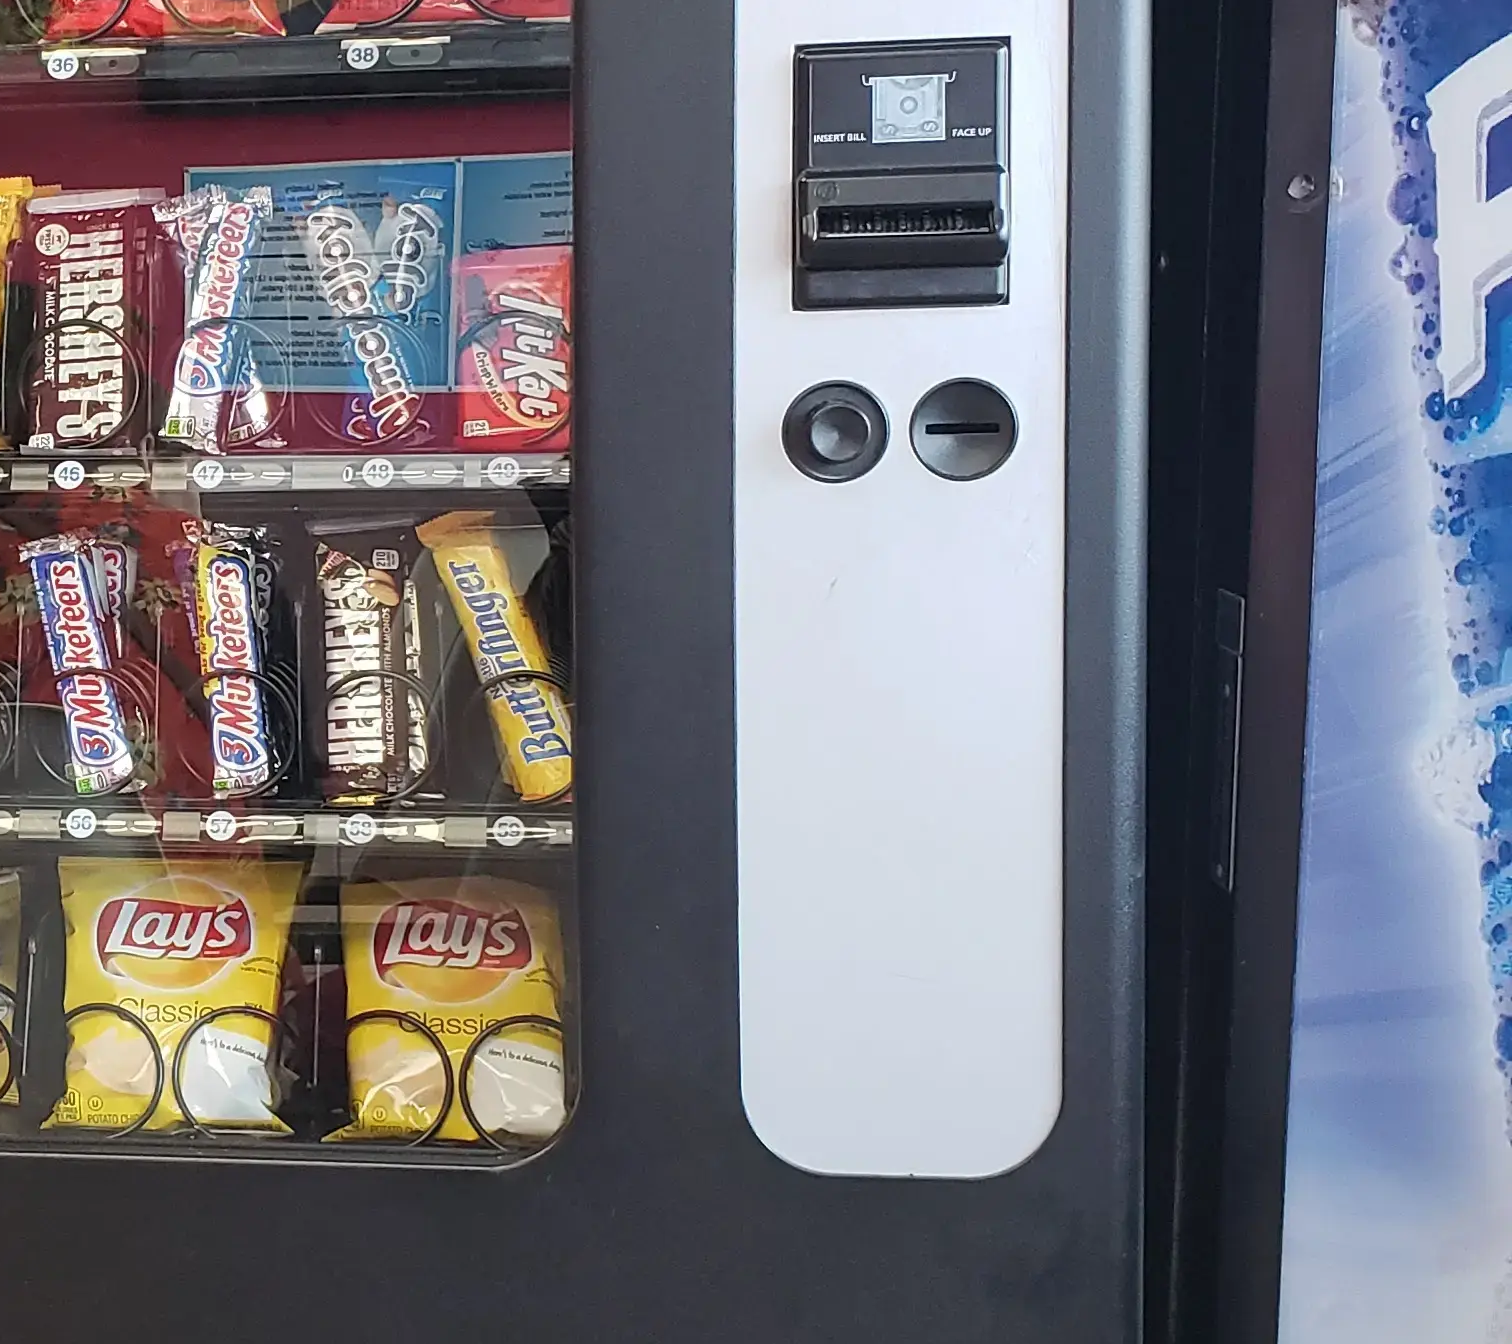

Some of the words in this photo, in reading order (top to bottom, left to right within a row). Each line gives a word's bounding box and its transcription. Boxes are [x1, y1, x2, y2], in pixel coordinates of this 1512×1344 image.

[51, 57, 75, 73] 36
[350, 47, 375, 63] 38
[813, 133, 845, 144] INSERT
[847, 132, 867, 143] BILL
[951, 128, 976, 138] FACE
[977, 126, 993, 137] UP
[196, 202, 252, 364] Msketeers
[44, 290, 58, 317] MILK
[56, 229, 126, 439] HERSHEY'S
[43, 317, 58, 382] COCOLATE
[474, 350, 491, 383] Crisp
[483, 377, 510, 413] Wafers
[57, 466, 81, 483] 46
[196, 465, 220, 482] 47
[365, 464, 391, 481] 48
[375, 550, 386, 569] 210
[382, 607, 392, 644] ALMONDS
[384, 678, 396, 731] CHOCOLATE
[80, 736, 109, 756] 3
[219, 737, 250, 762] 3
[386, 731, 396, 757] MILK
[70, 814, 93, 831] 56
[209, 818, 233, 834] 57
[104, 900, 243, 960] Lay's
[382, 905, 519, 968] Lay's
[117, 997, 215, 1024] Classic
[398, 1010, 503, 1036] Classic
[87, 1113, 119, 1125] POTATO
